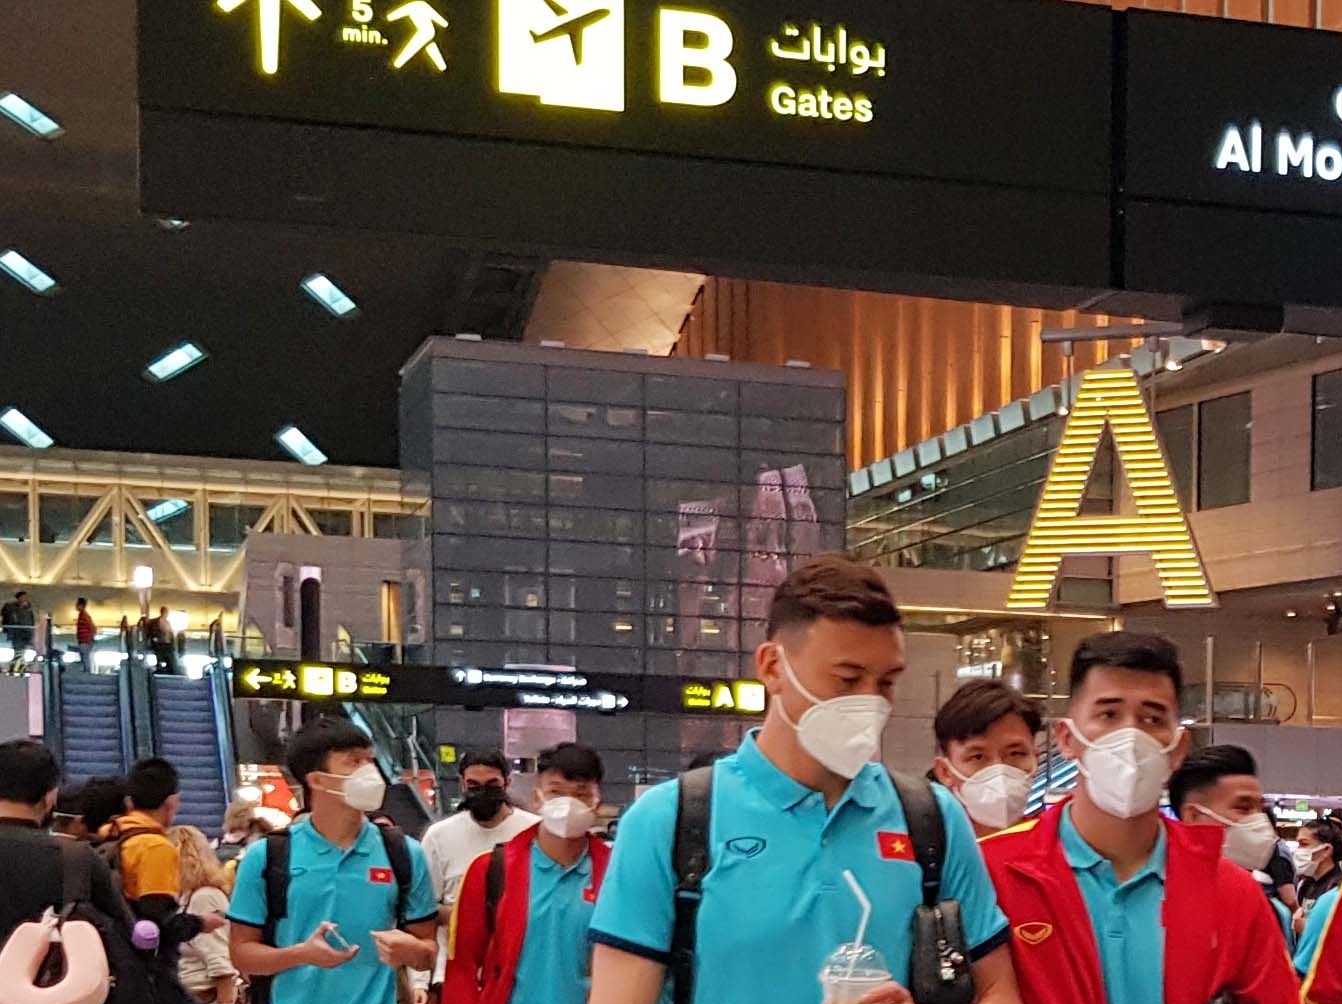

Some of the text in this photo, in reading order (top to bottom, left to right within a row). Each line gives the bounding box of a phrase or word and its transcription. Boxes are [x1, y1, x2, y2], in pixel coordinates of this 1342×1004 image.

[352, 0, 373, 22] 5
[342, 25, 388, 45] min.
[769, 25, 886, 77] بوابات
[658, 8, 737, 106] B
[770, 84, 873, 122] Gates
[1216, 123, 1263, 173] Al
[1006, 369, 1216, 608] A
[337, 671, 358, 694] B
[714, 686, 735, 708] A
